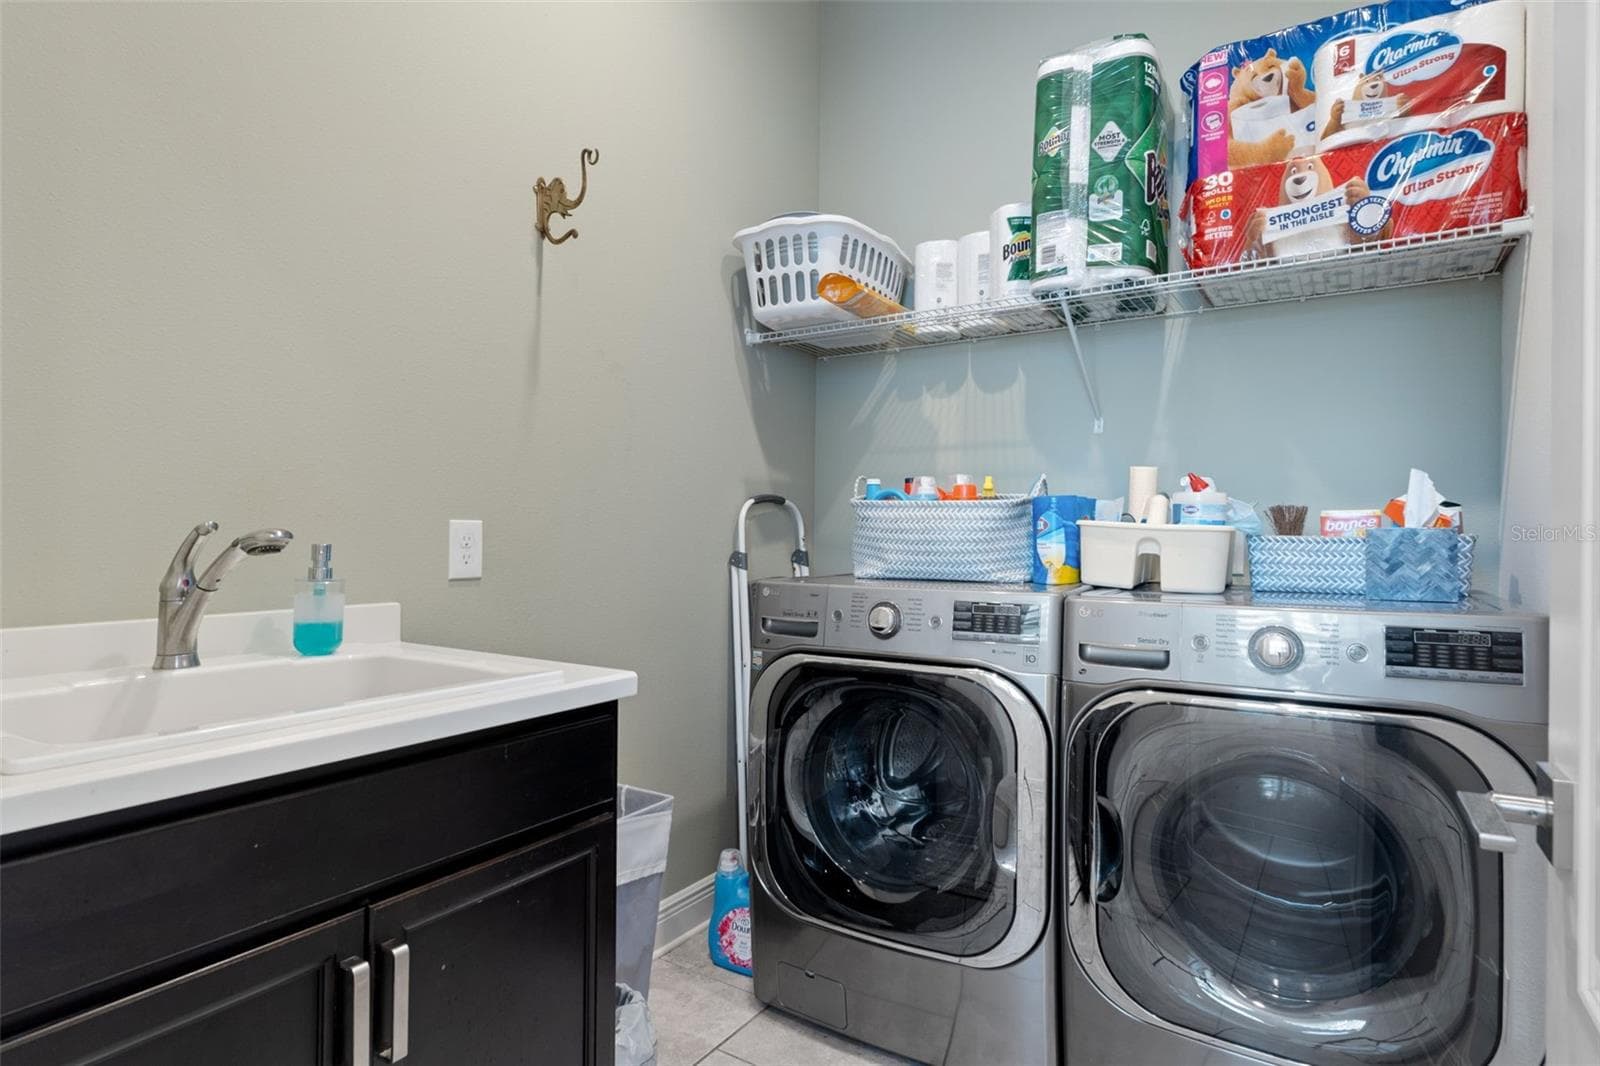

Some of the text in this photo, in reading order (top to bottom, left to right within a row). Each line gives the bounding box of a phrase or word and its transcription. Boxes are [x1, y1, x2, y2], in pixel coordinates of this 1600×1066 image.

[1371, 31, 1441, 71] Charmin
[1392, 51, 1456, 80] Ultra Strong
[1098, 132, 1121, 141] MOST
[1376, 135, 1463, 183] Charmin
[1203, 171, 1234, 190] 30
[1402, 179, 1435, 196] Ultra
[1268, 196, 1344, 226] STRONGEST
[1279, 209, 1335, 231] IN THE AISLE
[1003, 239, 1031, 261] Boun
[1325, 517, 1377, 533] bounce
[1158, 638, 1170, 646] Dry
[731, 921, 751, 934] Down
